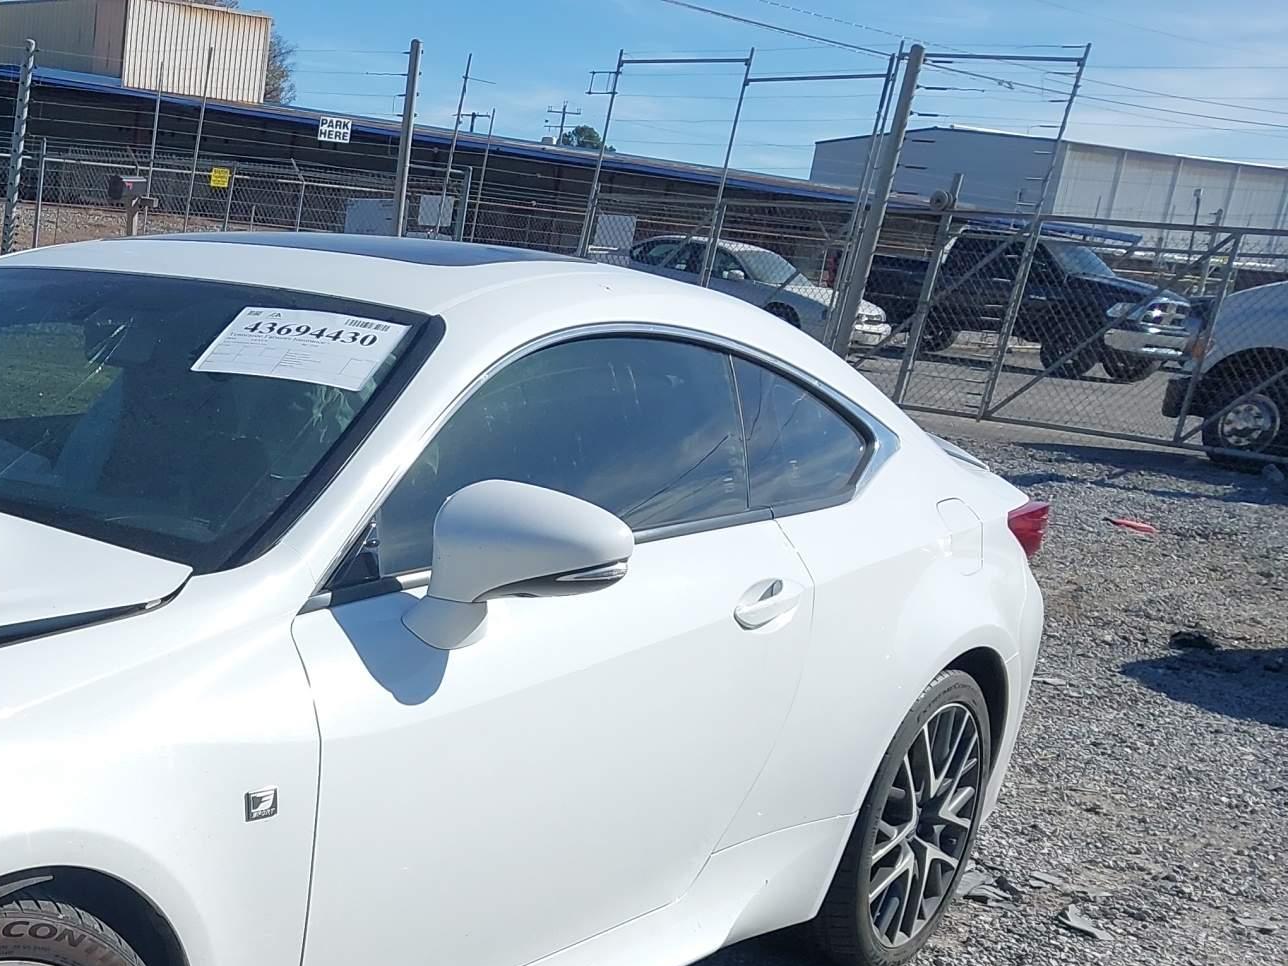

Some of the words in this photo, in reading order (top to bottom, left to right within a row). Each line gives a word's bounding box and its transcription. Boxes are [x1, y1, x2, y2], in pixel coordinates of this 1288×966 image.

[320, 118, 350, 131] PARK
[319, 129, 349, 141] HERE
[244, 321, 378, 347] 43694430
